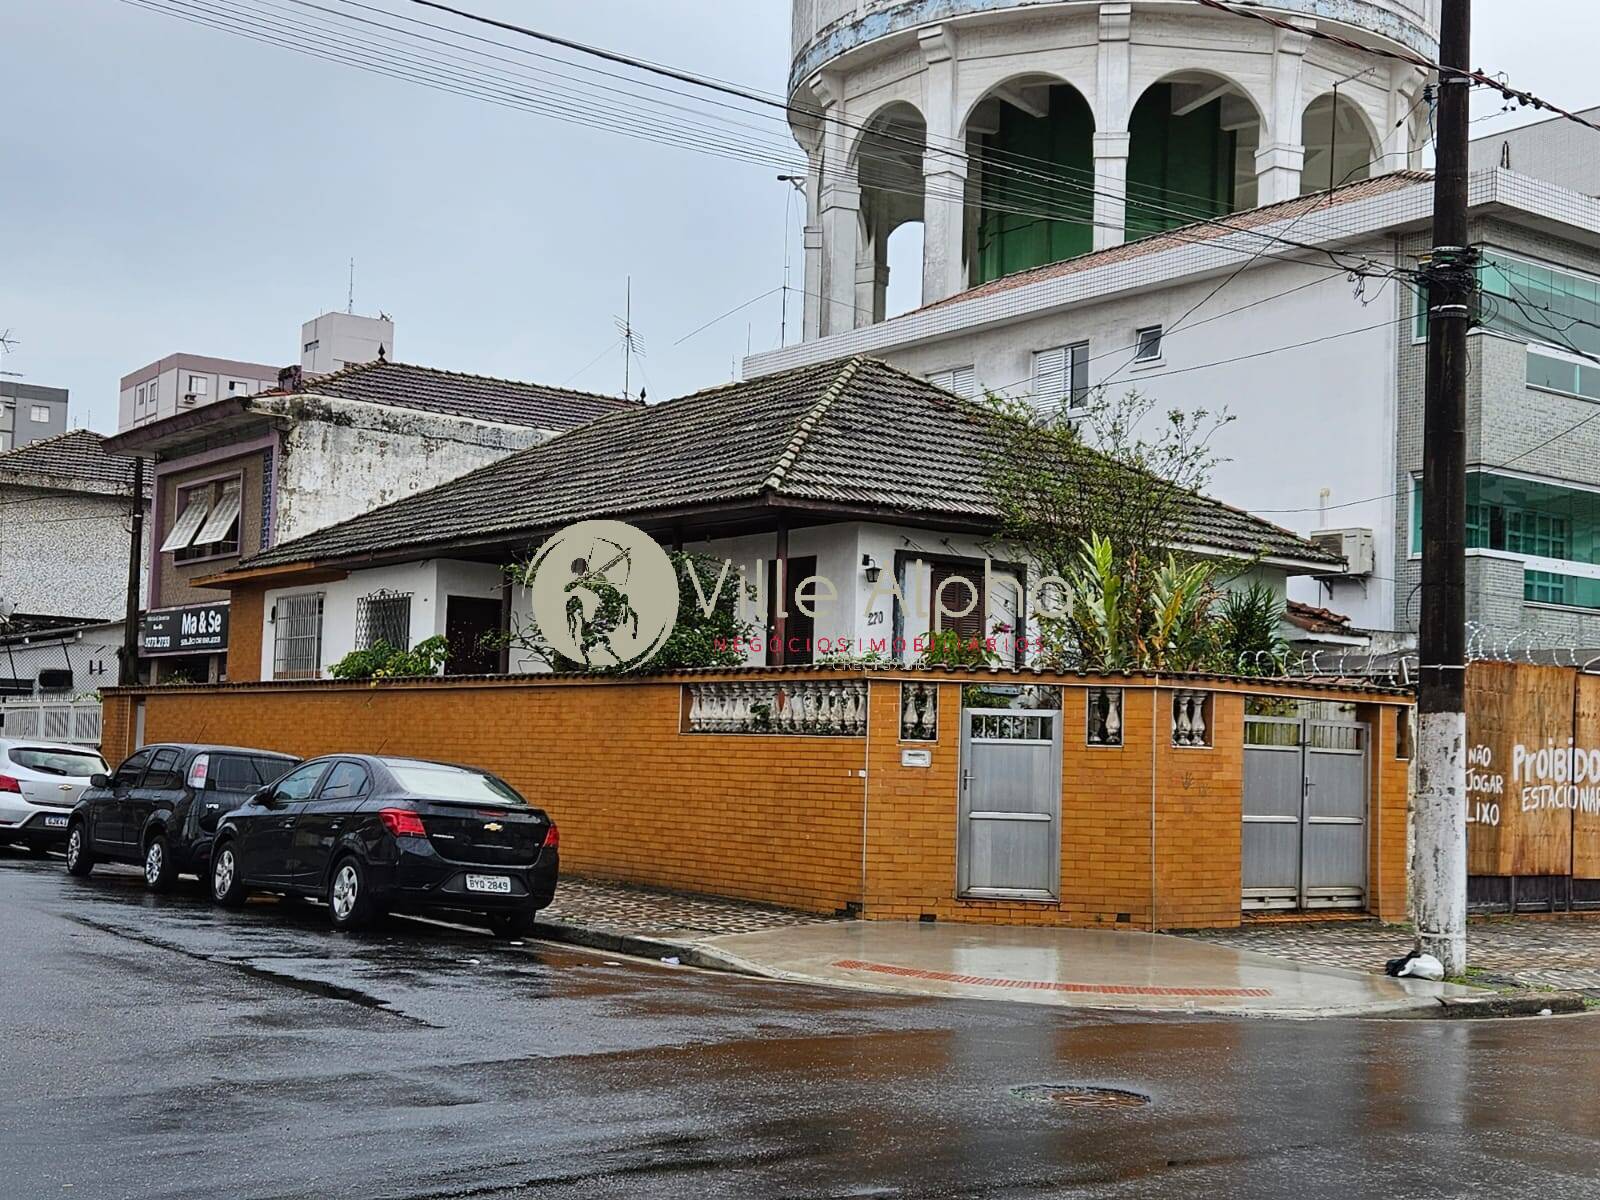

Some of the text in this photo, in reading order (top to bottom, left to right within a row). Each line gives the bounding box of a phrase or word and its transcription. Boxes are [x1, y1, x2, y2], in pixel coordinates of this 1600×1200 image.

[181, 610, 221, 634] Ma & Se
[867, 611, 884, 626] 270
[1468, 744, 1492, 767] NÃO
[1465, 767, 1504, 795] JOGAR
[487, 881, 508, 891] 2849
